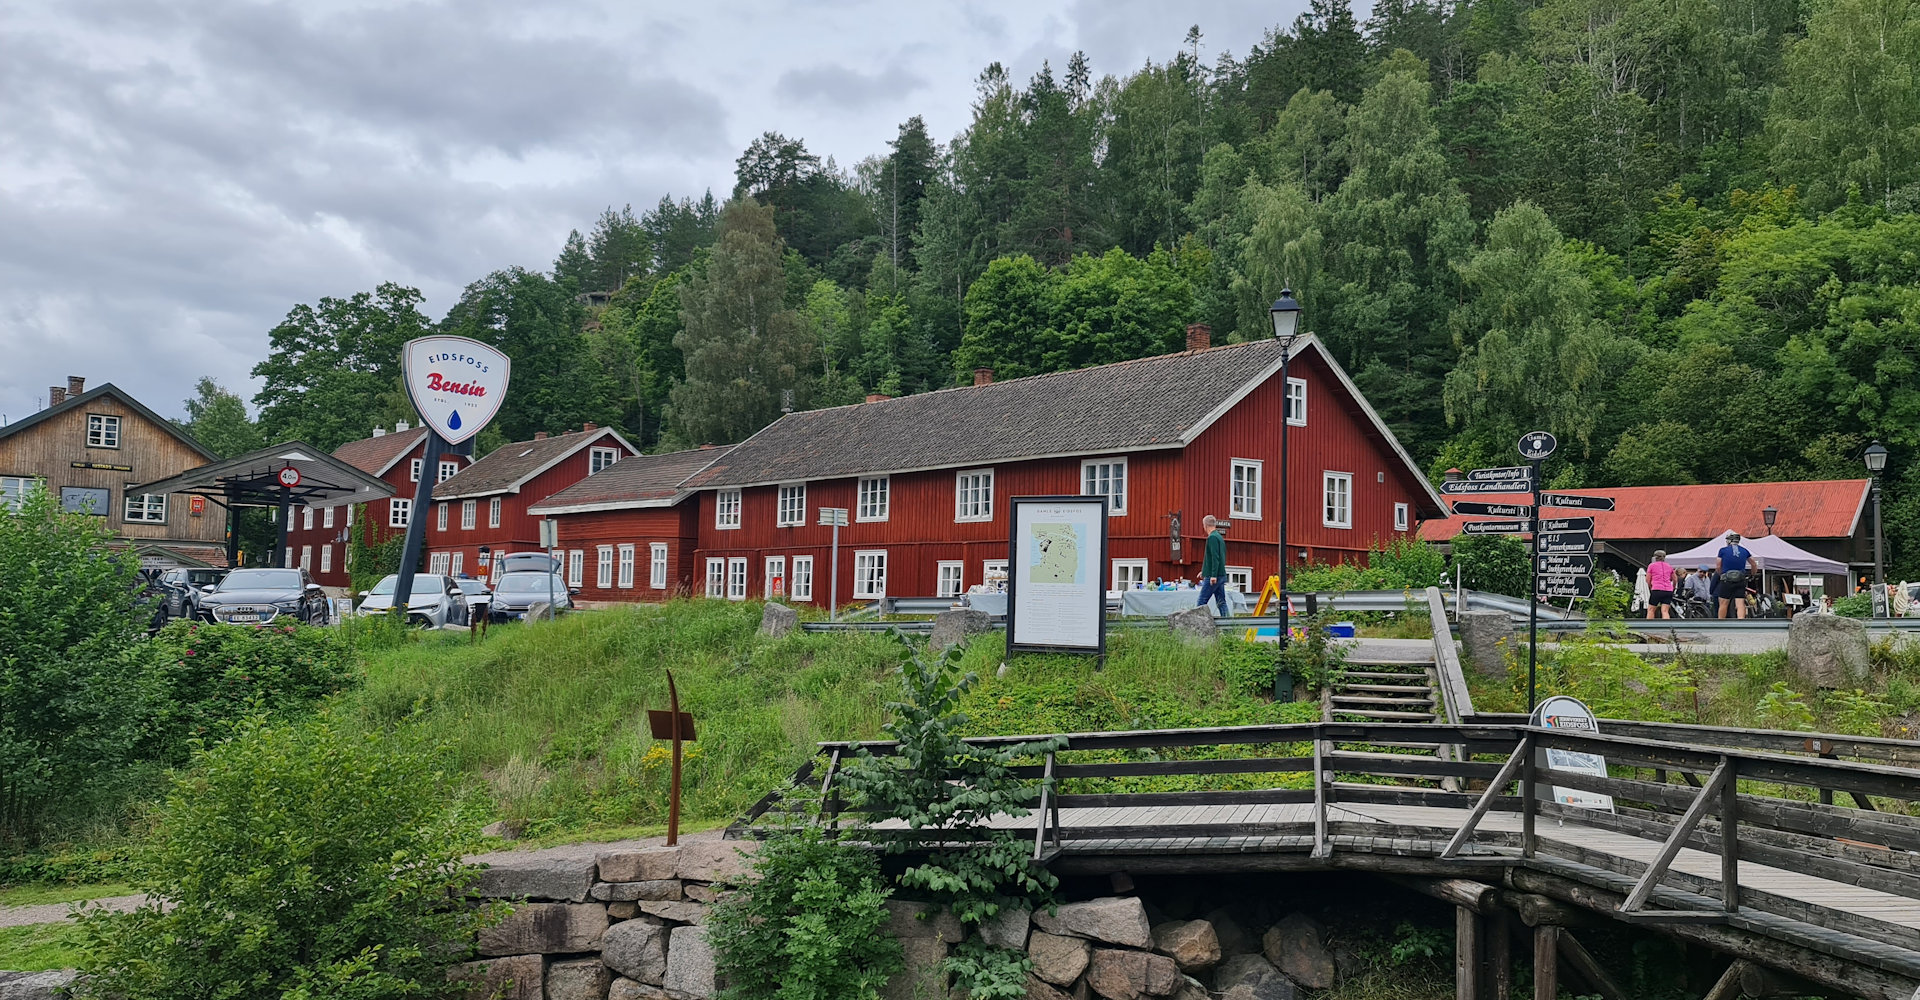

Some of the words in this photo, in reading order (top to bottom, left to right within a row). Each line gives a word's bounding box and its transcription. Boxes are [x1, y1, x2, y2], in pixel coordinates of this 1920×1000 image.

[428, 353, 489, 373] EIDSFOSS
[426, 372, 487, 397] Bensin
[1527, 433, 1547, 441] Gamle
[1474, 469, 1520, 480] Turistkontor/Info
[1448, 482, 1478, 493] Eidsfoss
[1479, 481, 1527, 491] Landhandleri
[1555, 496, 1583, 506] Kultursti
[1487, 506, 1517, 514] Kultursti
[1467, 522, 1519, 532] Postkontormuseum
[1548, 521, 1569, 530] Kultursti
[1564, 577, 1576, 585] Hall
[1553, 585, 1580, 596] Kraftverket
[1559, 721, 1589, 729] EIDSFOSS
